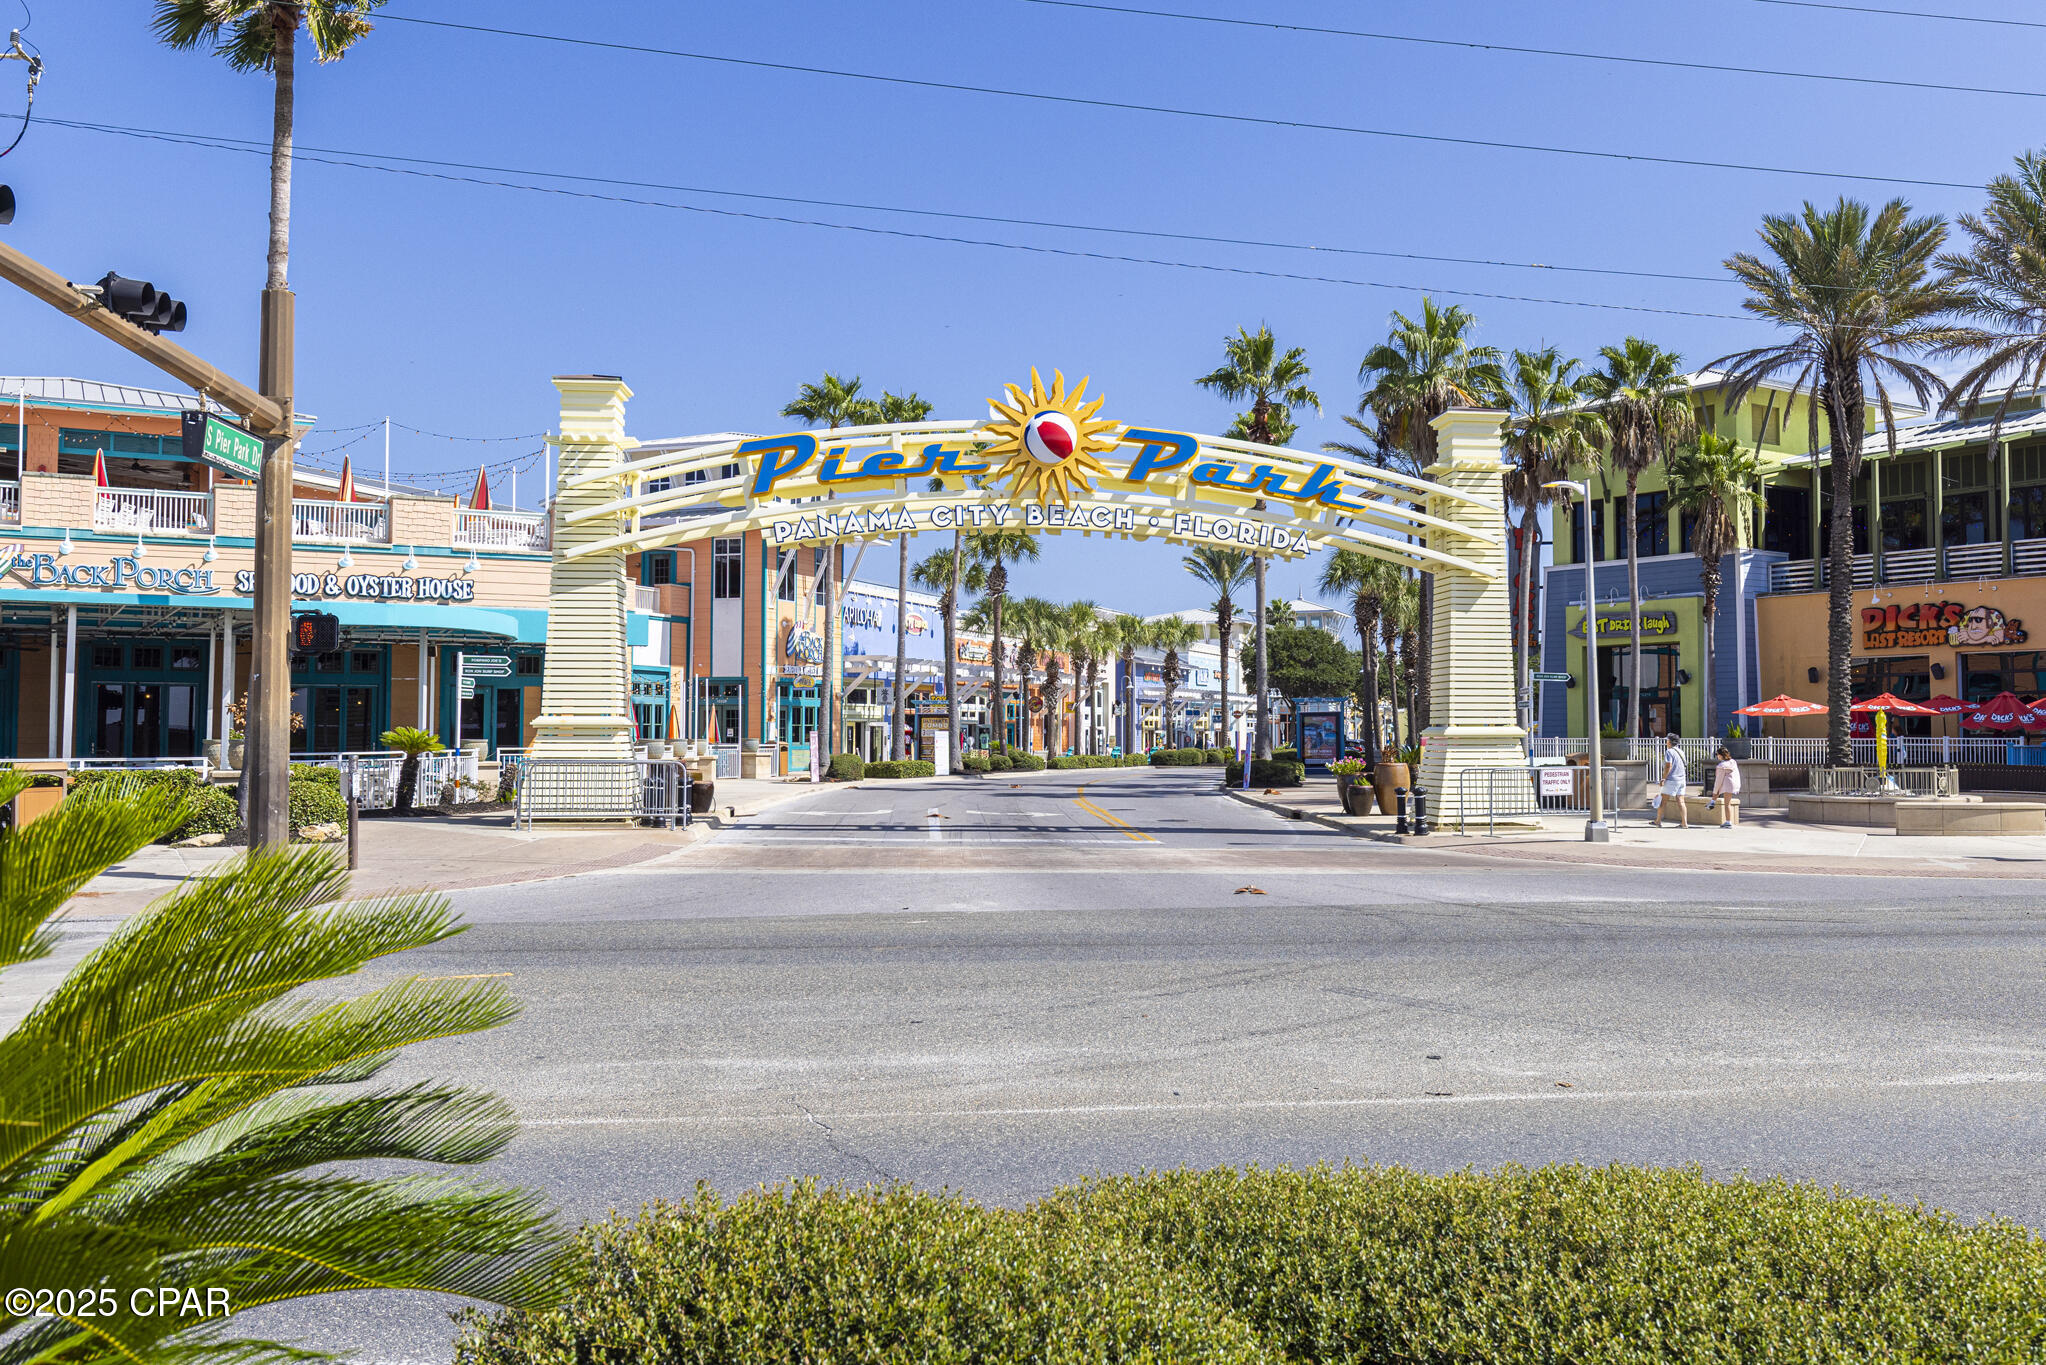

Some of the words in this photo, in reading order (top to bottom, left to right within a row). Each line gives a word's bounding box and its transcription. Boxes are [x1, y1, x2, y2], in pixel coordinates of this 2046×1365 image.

[206, 425, 213, 446] S
[215, 429, 231, 454] Pier
[233, 437, 250, 462] Park
[251, 445, 261, 467] Dr
[732, 432, 991, 498] Pier
[1117, 426, 1369, 513] Park
[773, 507, 916, 543] PANAMA
[930, 503, 1010, 526] CITY
[1026, 503, 1134, 530] BEACH
[1174, 513, 1311, 555] FLORIDA
[11, 554, 34, 569] the
[32, 553, 110, 587] BACK
[111, 556, 220, 595] PORCH
[236, 569, 320, 596] SEOD
[324, 573, 343, 597] &
[345, 574, 414, 600] OYSTER
[415, 577, 475, 601] HOUSE
[1582, 618, 1609, 634] ET
[1609, 619, 1642, 631] DRI
[1644, 615, 1670, 634] laugh
[1861, 601, 1964, 632] DICK'S
[1863, 632, 1897, 649] LAST
[1896, 630, 1947, 648] RESORT
[1991, 712, 2014, 721] DICK'S
